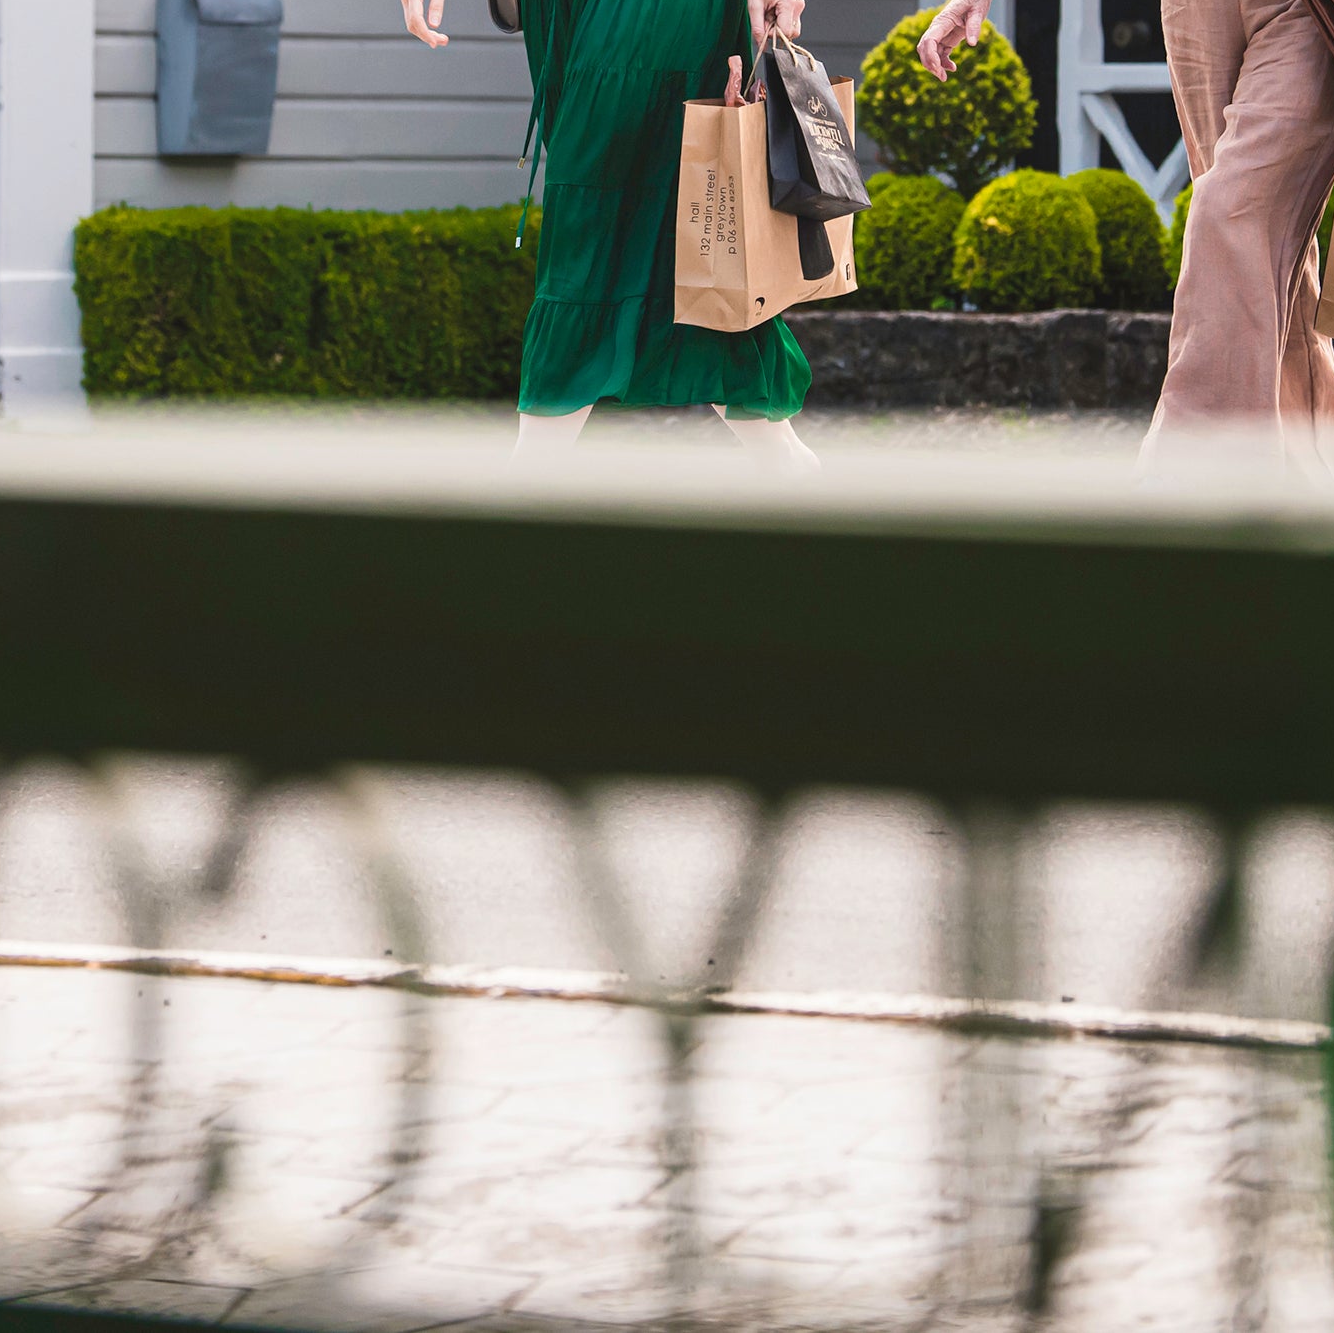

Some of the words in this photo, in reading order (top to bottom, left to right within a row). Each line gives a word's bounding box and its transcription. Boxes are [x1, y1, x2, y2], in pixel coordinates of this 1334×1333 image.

[705, 169, 715, 202] street
[689, 202, 700, 223] hall
[703, 205, 713, 234] main
[716, 186, 727, 242] greytown
[729, 206, 737, 226] 304
[727, 229, 737, 243] 06
[700, 237, 711, 256] 132
[728, 246, 737, 255] p
